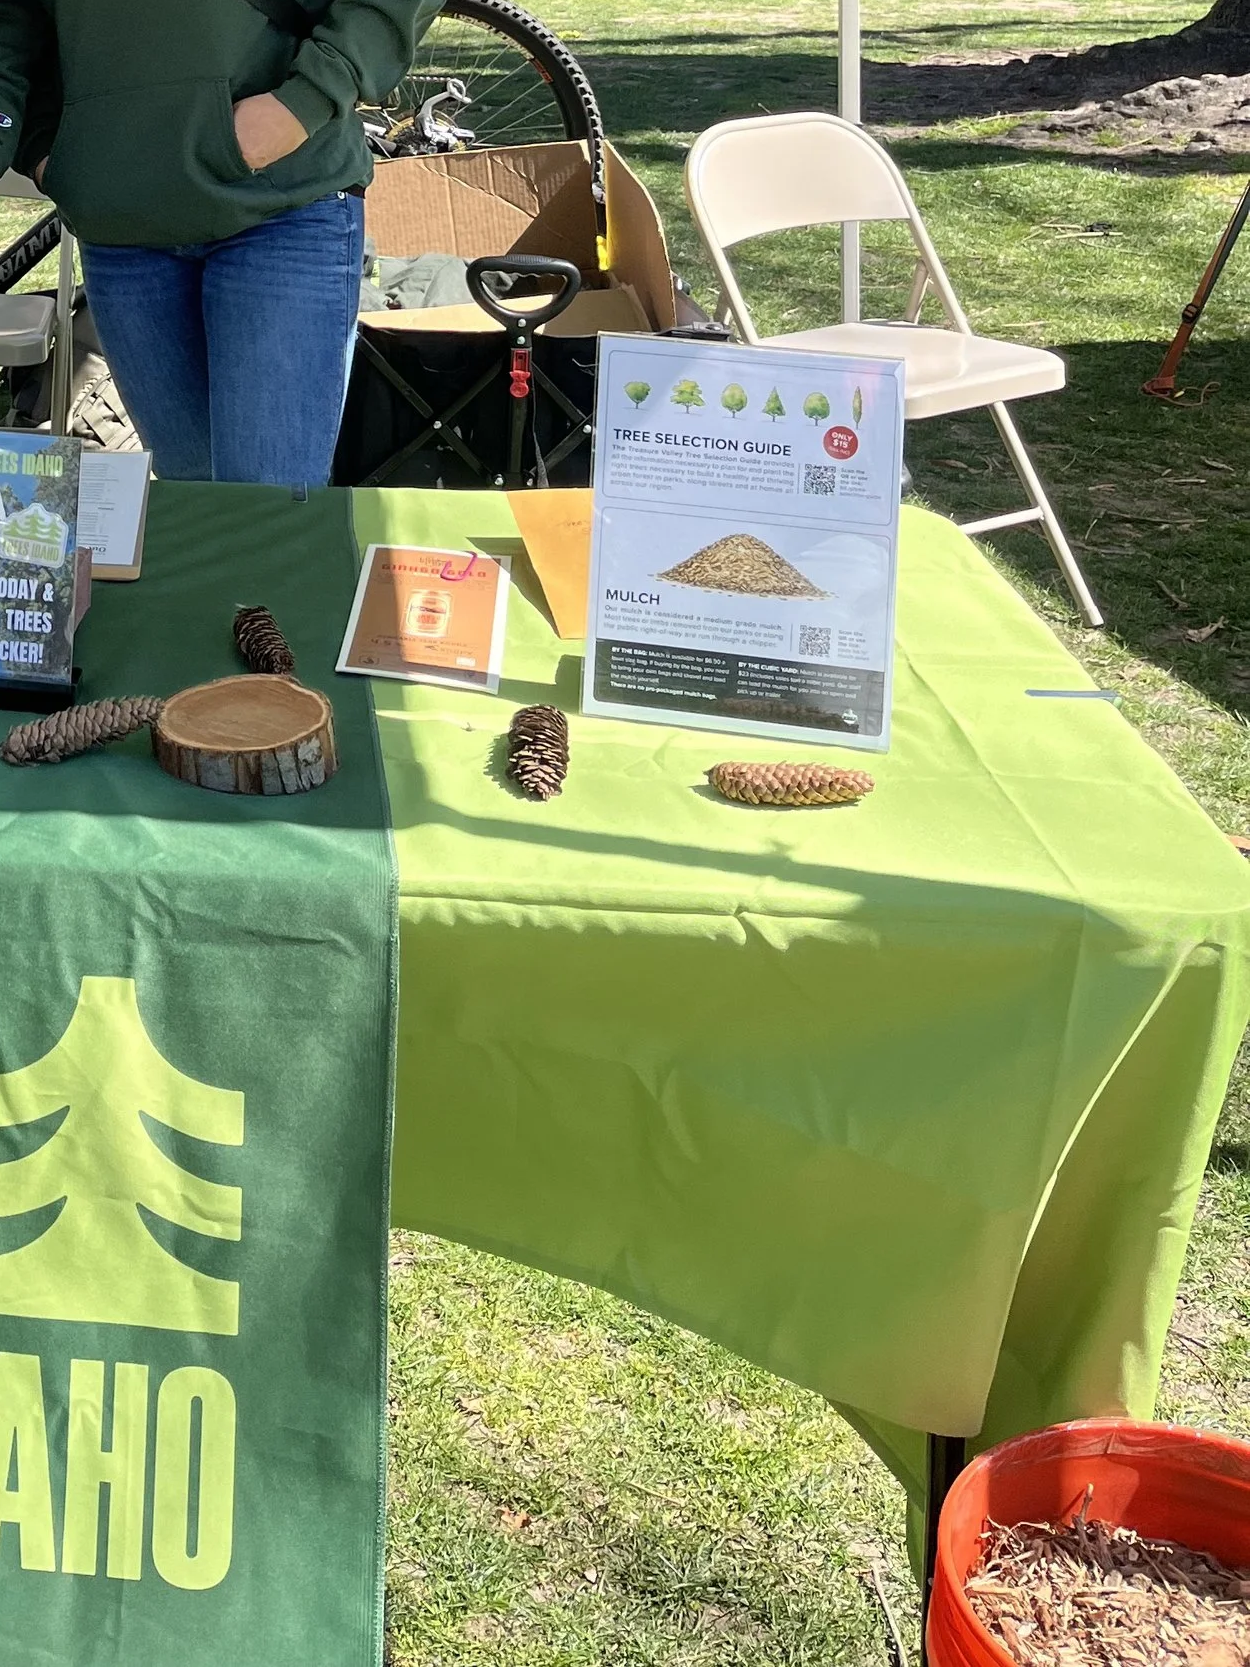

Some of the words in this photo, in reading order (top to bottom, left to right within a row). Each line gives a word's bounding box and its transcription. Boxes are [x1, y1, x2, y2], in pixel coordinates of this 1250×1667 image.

[612, 427, 650, 443] TREE
[654, 431, 738, 451] SELECTION
[742, 439, 792, 456] GUIDE
[831, 432, 853, 441] ONLY
[833, 439, 848, 448] $15
[22, 453, 64, 478] IDAHO
[2, 538, 29, 558] TREES
[32, 541, 60, 562] IDAHO
[42, 582, 54, 602] &
[604, 587, 660, 605] MULCH
[6, 609, 52, 633] TREES
